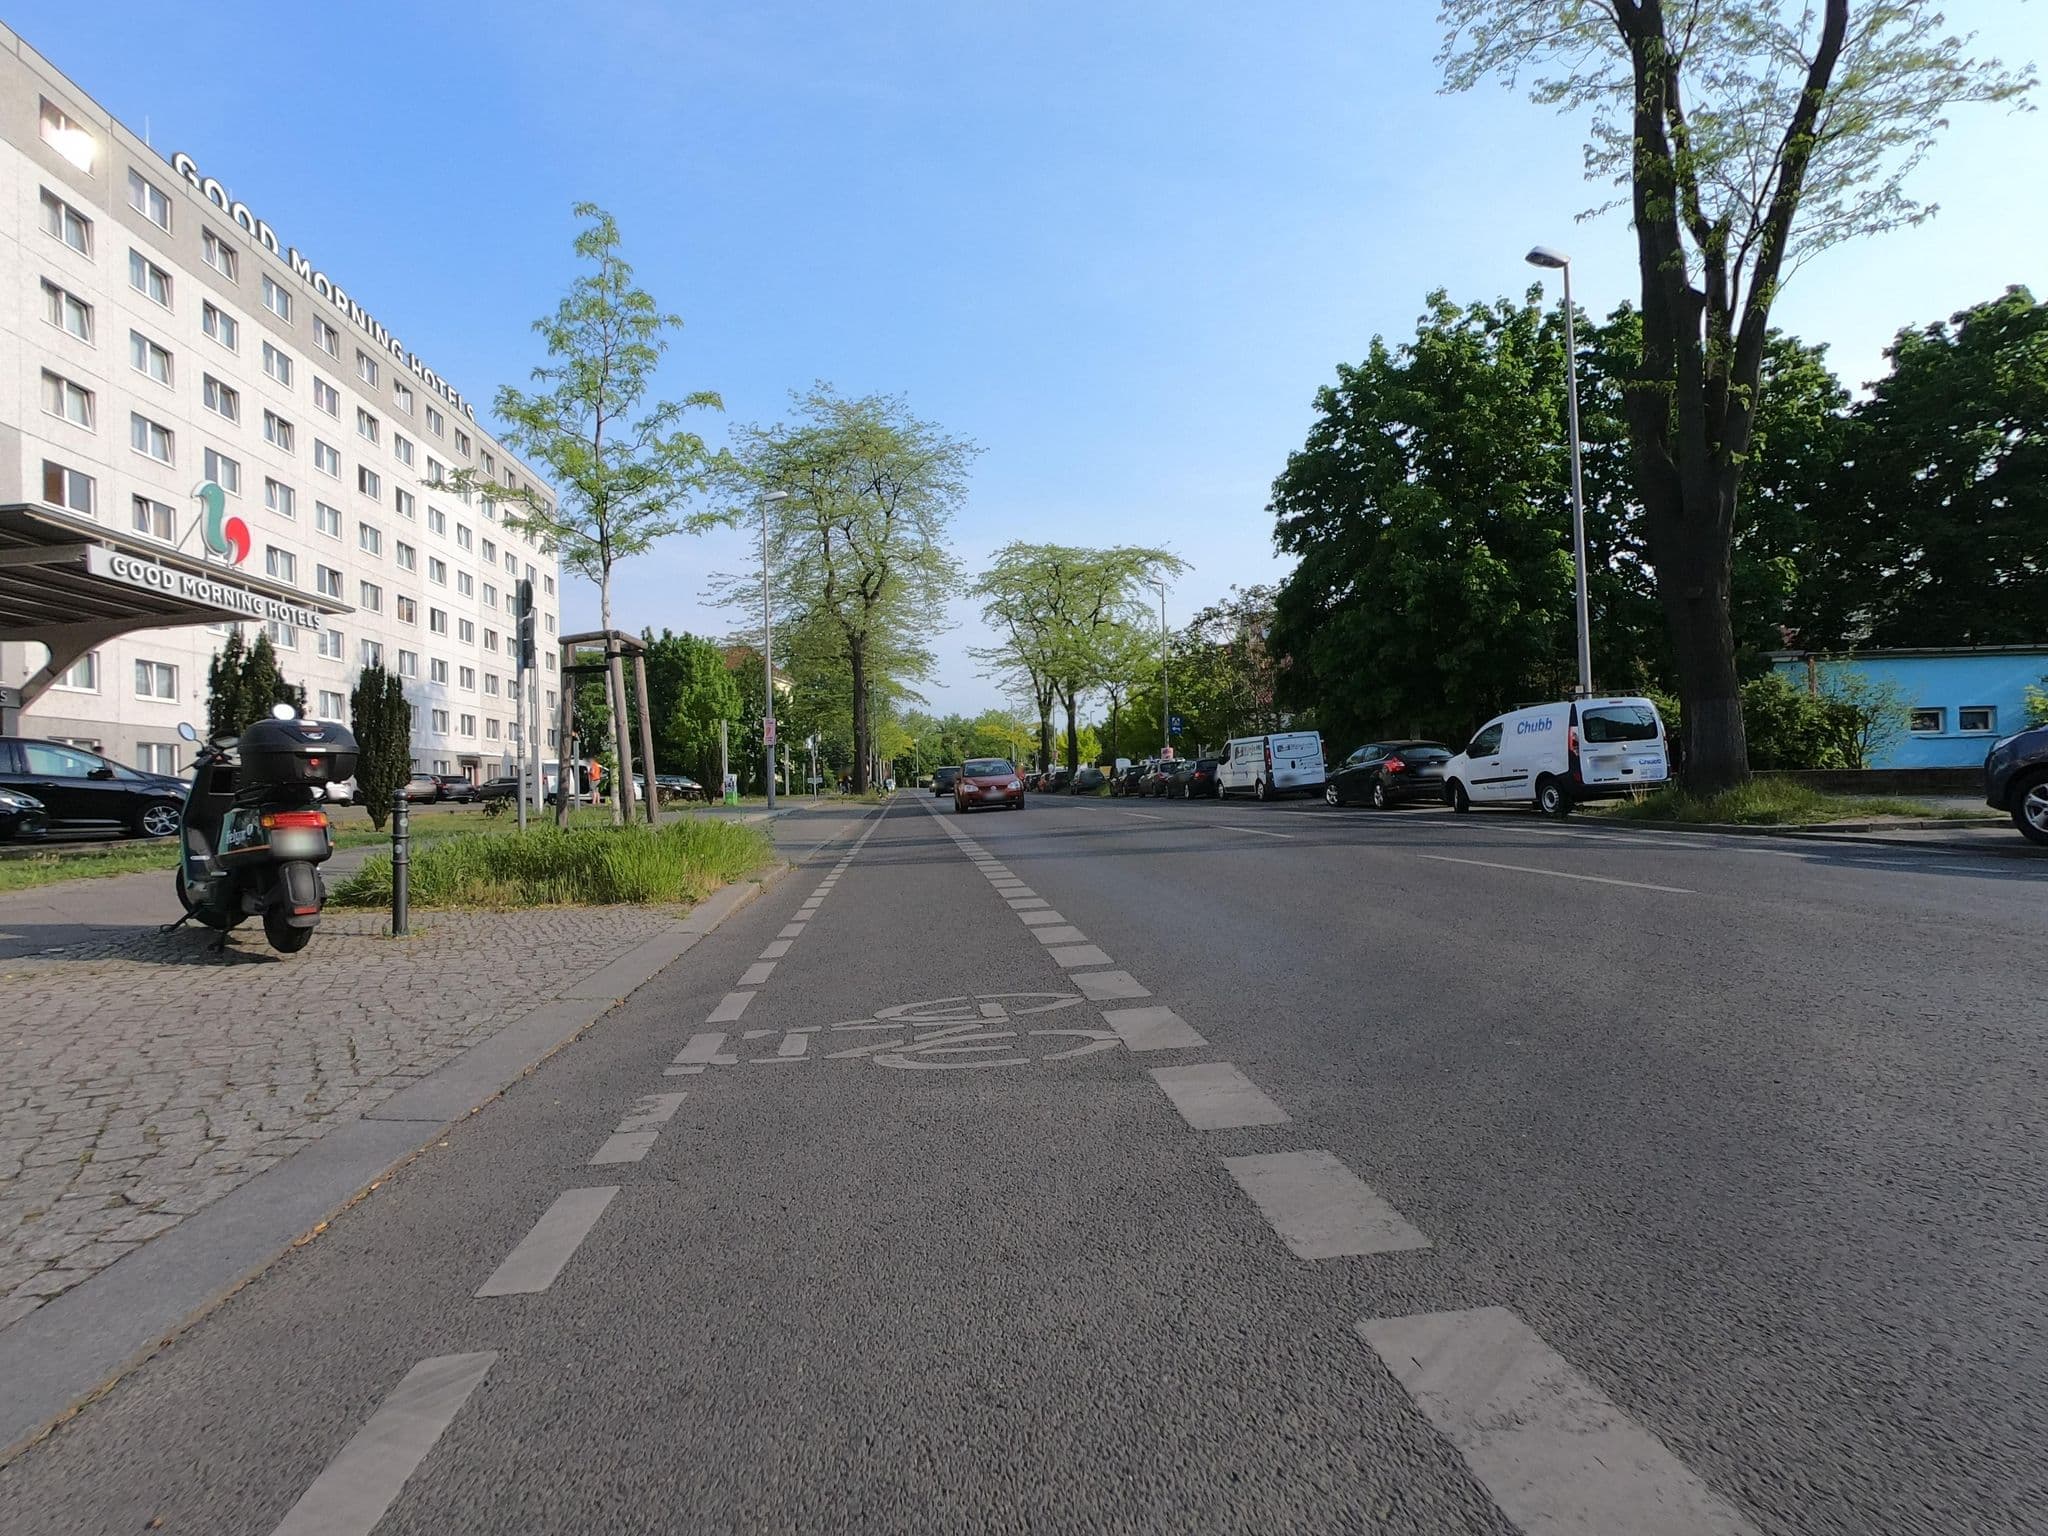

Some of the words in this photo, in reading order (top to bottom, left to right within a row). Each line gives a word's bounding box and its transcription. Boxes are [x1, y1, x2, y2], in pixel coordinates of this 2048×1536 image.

[172, 152, 280, 256] GOOD
[289, 247, 404, 361] MORNING
[409, 353, 475, 423] HOTELS
[110, 556, 175, 589] GOOD
[180, 576, 263, 614] MORNING
[267, 600, 321, 630] HOTELS
[1517, 717, 1553, 735] Chubb
